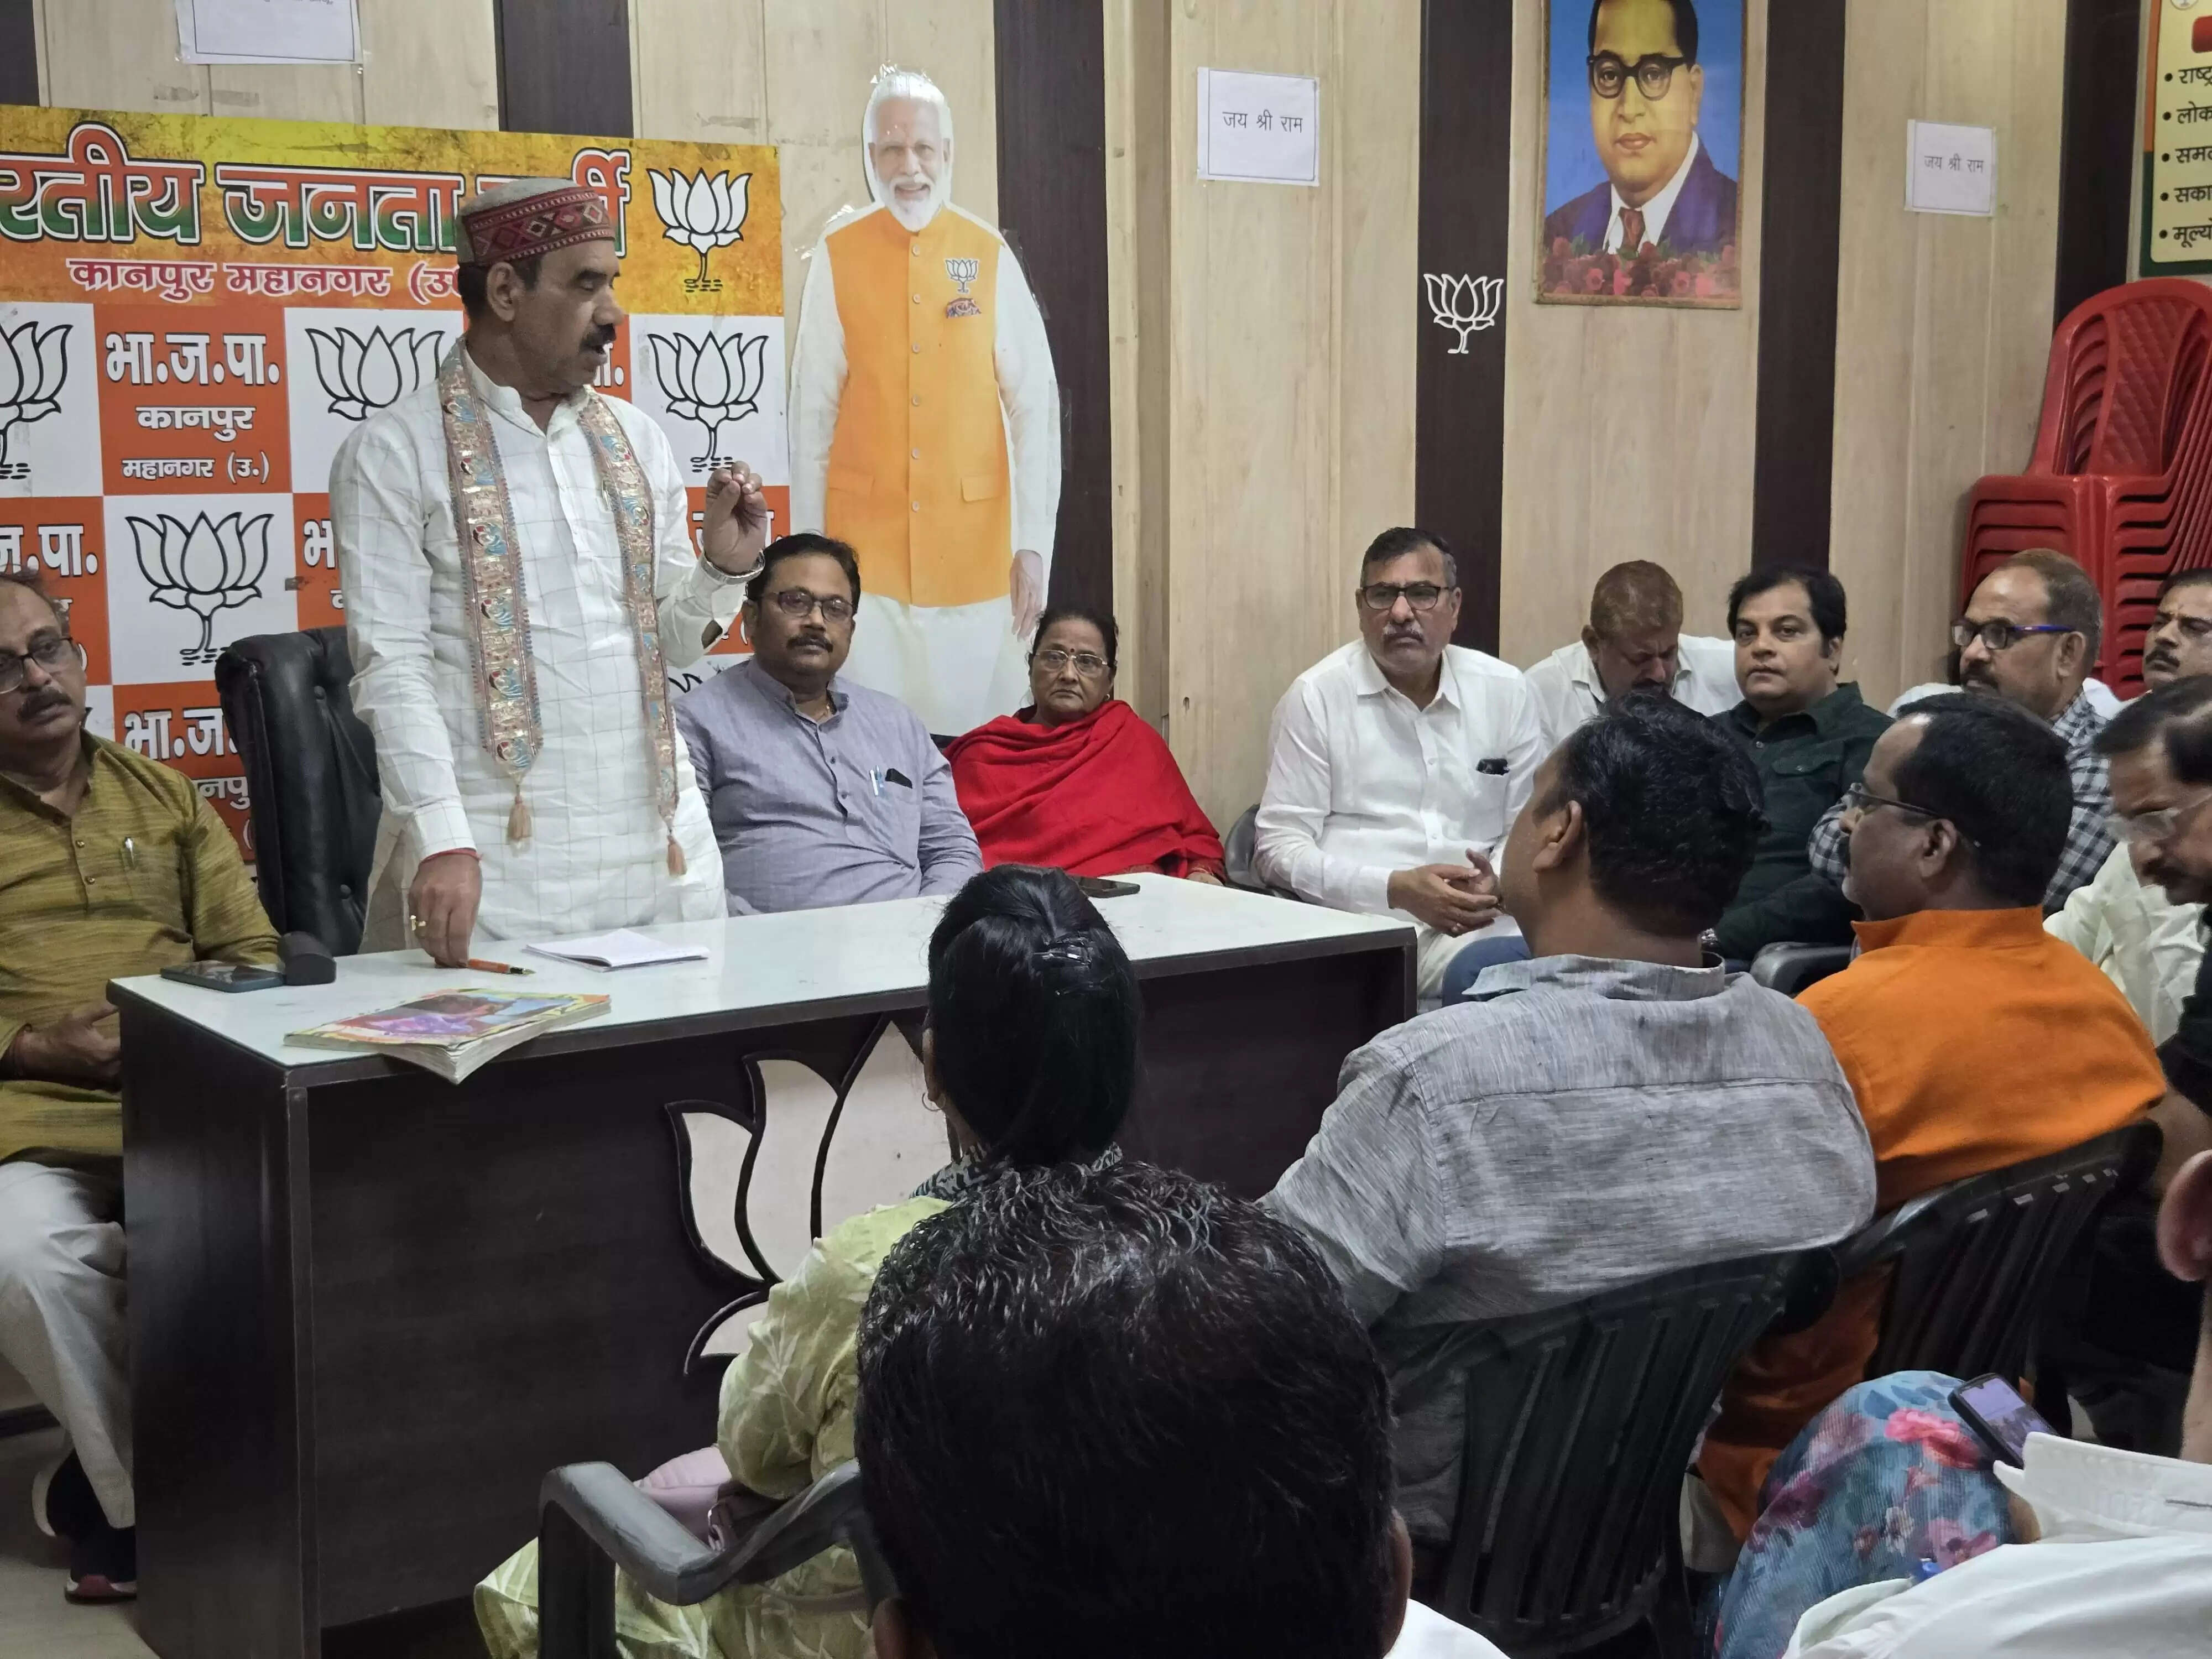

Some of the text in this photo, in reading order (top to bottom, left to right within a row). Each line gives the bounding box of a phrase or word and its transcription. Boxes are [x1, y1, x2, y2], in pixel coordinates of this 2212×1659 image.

[1222, 109, 1303, 133] जय श्री राम
[2176, 101, 2212, 124] लोक
[1924, 153, 1984, 173] जय श्री राम
[0, 121, 206, 246] रतीय
[215, 164, 466, 253] जनता
[2173, 185, 2212, 202] सका
[66, 258, 217, 302] कानपुर
[223, 262, 393, 296] महानगर
[106, 332, 281, 385] भा.ज.पा.
[135, 405, 256, 441] कानपुर
[122, 451, 270, 484] महानगर (उ.)
[124, 706, 238, 761] भा.ज.
